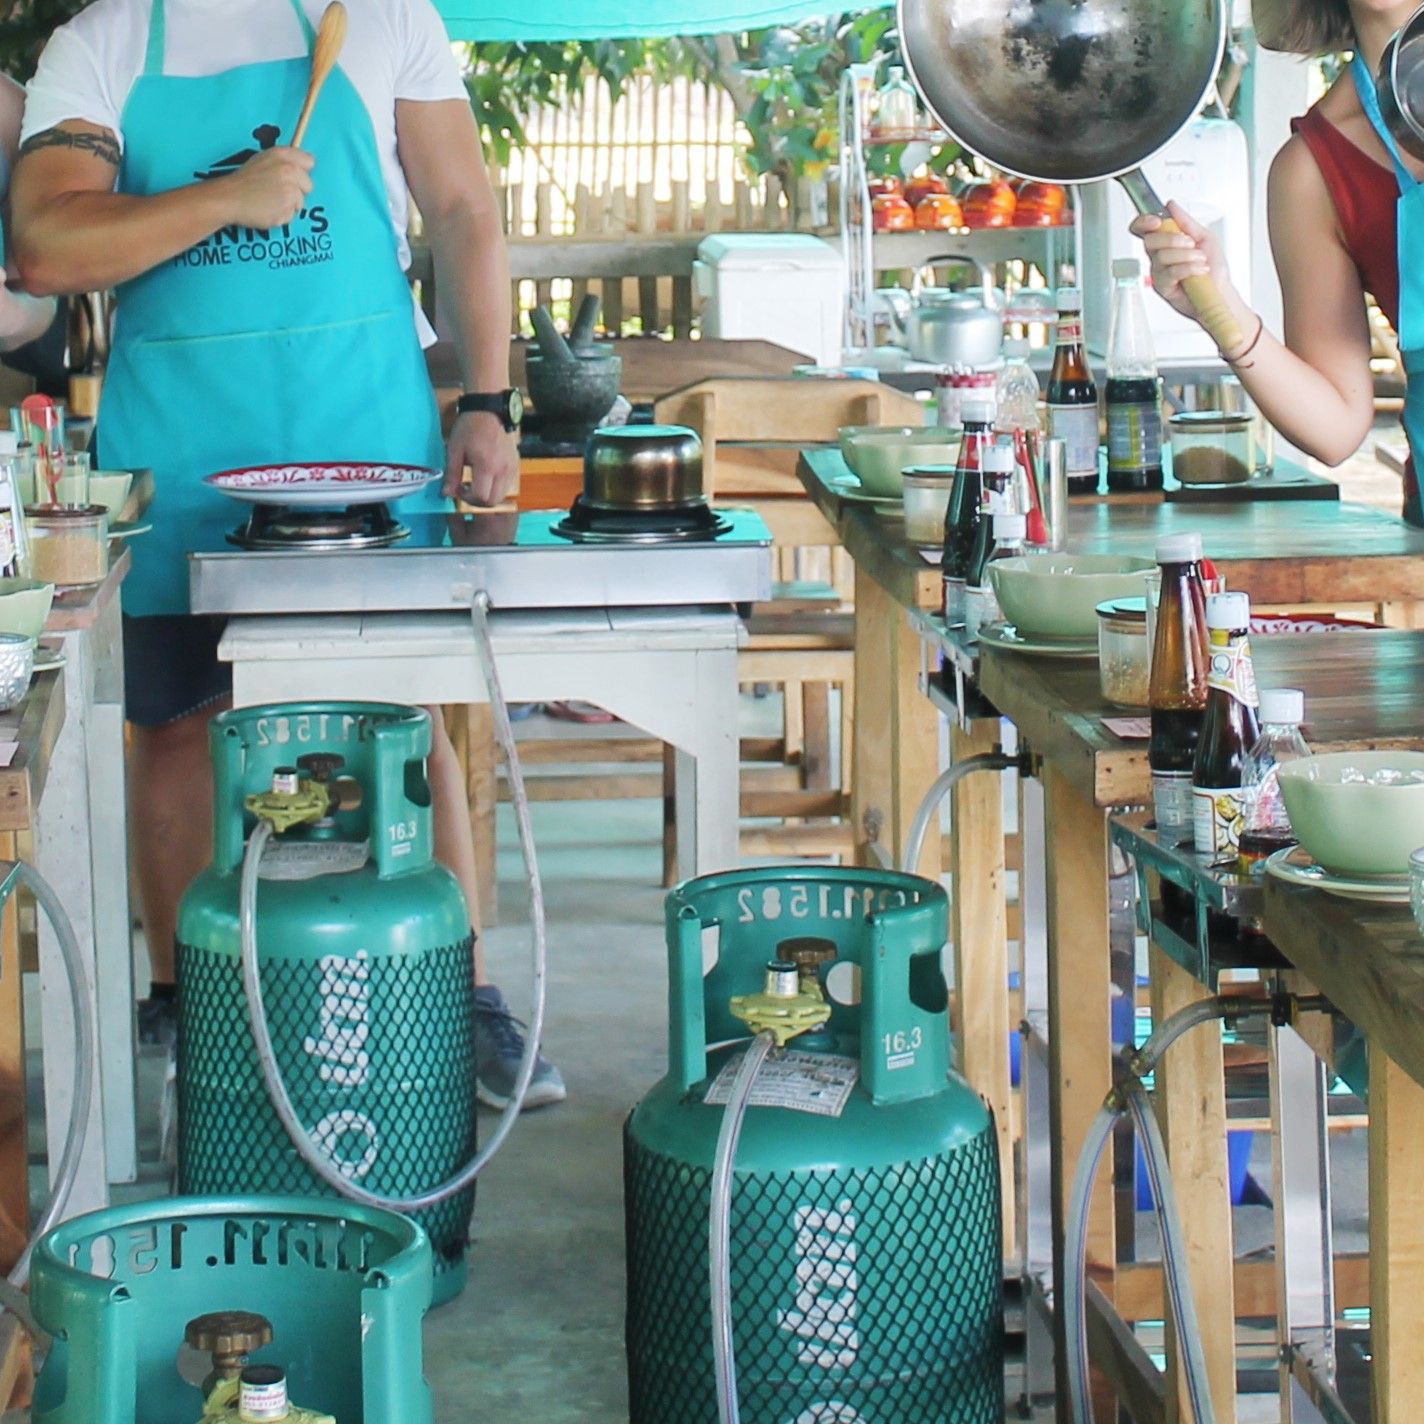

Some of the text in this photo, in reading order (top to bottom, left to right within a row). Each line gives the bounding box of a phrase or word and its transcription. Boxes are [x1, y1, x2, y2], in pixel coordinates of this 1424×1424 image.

[237, 233, 333, 263] COOKING
[268, 251, 334, 270] CHIANGMAI
[389, 821, 417, 841] 16.3
[881, 1026, 923, 1055] 16.3
